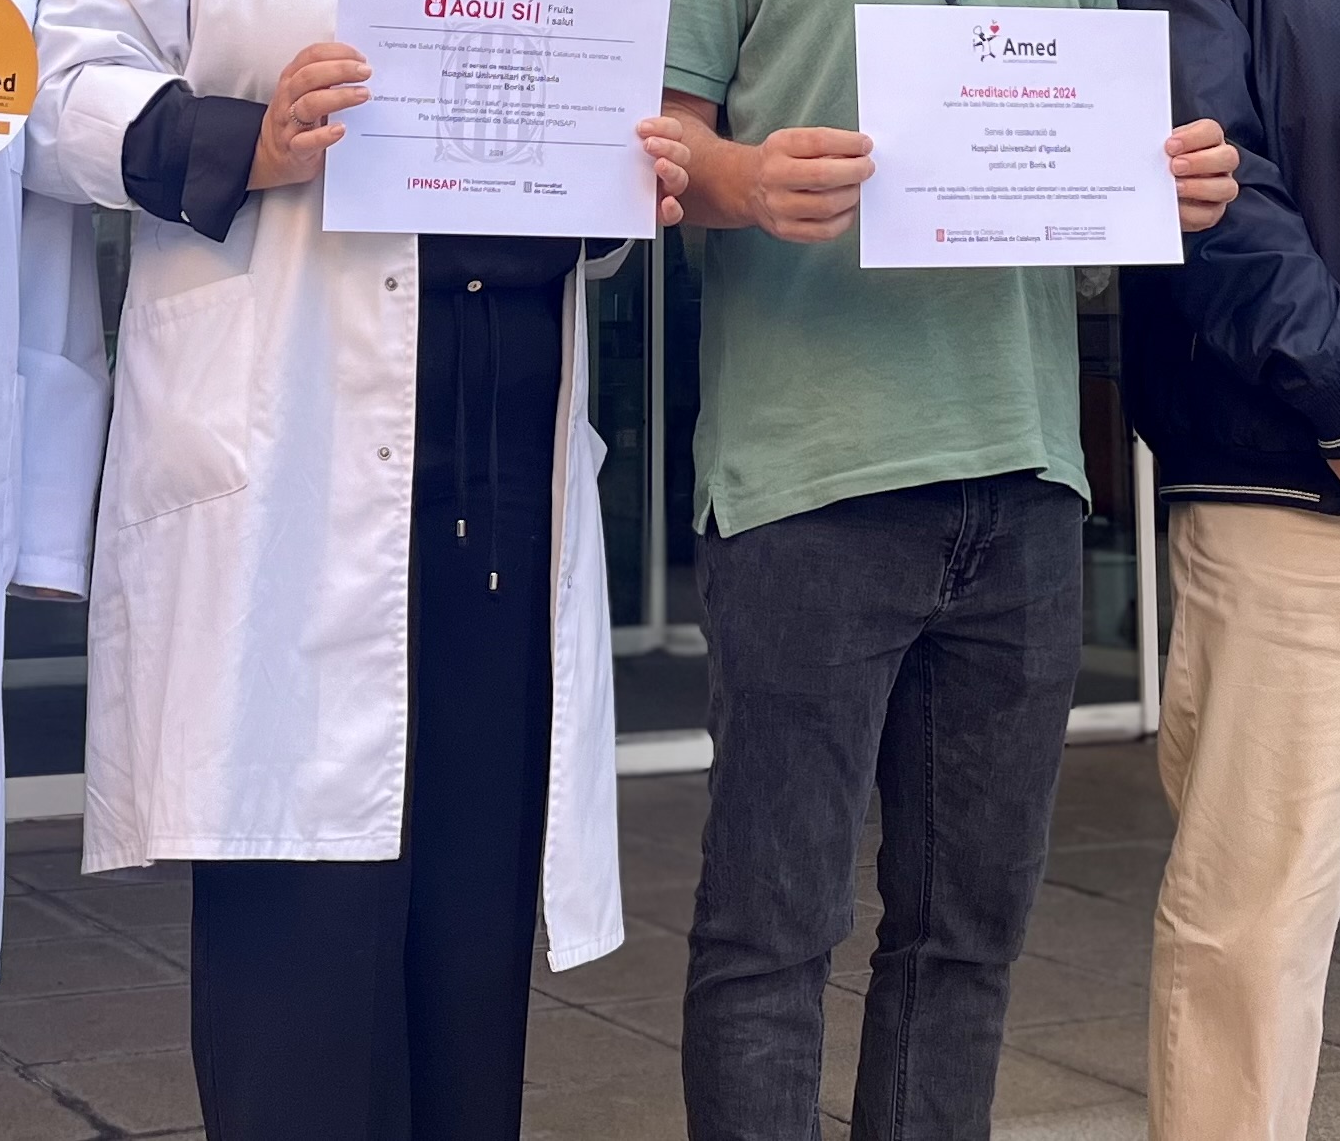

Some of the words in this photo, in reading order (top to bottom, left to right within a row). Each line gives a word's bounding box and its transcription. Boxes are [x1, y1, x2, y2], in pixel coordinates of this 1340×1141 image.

[547, 3, 574, 14] Fruita
[546, 16, 550, 24] i
[551, 17, 574, 27] salut
[1002, 38, 1057, 57] Amed
[960, 85, 1019, 98] Acreditació
[1020, 86, 1051, 99] Amed
[1052, 86, 1077, 99] 2024
[412, 178, 457, 190] PINSAP
